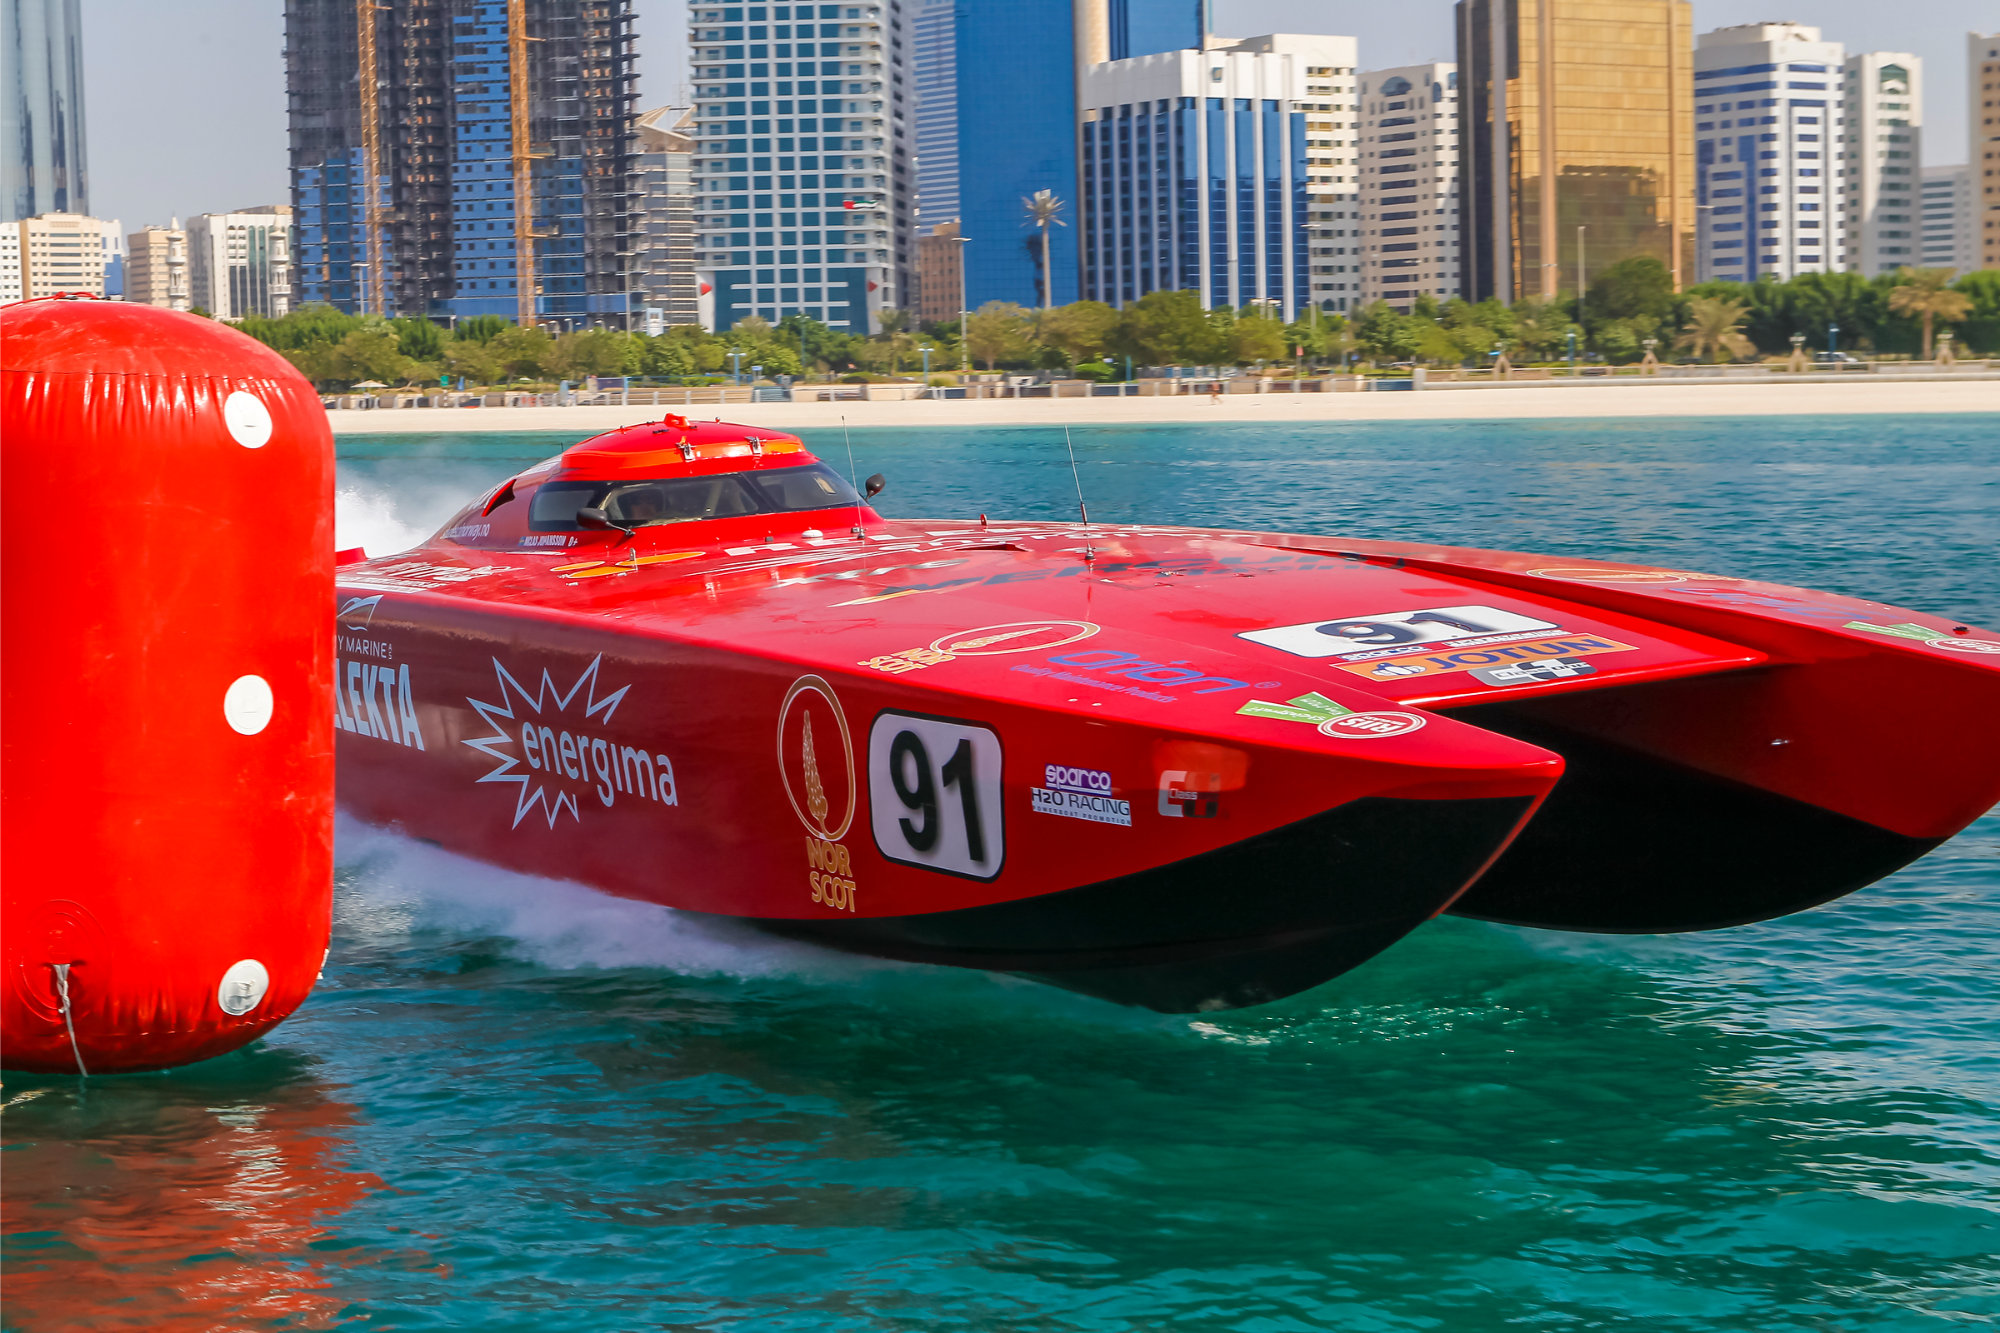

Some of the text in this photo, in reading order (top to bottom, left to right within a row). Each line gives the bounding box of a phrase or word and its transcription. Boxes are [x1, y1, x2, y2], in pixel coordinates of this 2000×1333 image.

[1315, 611, 1494, 644] 91
[346, 636, 387, 659] MARINE
[1429, 638, 1616, 670] JOTUN
[857, 655, 929, 674] SCOT
[334, 658, 426, 752] LEKTA
[521, 721, 678, 807] energima
[1045, 765, 1111, 790] sparco
[890, 730, 985, 863] 91
[1032, 788, 1130, 816] H2O RACING
[1168, 788, 1198, 800] Class
[1082, 812, 1132, 826] PROMOTION
[805, 836, 853, 878] NOR
[809, 871, 856, 913] SCOT
